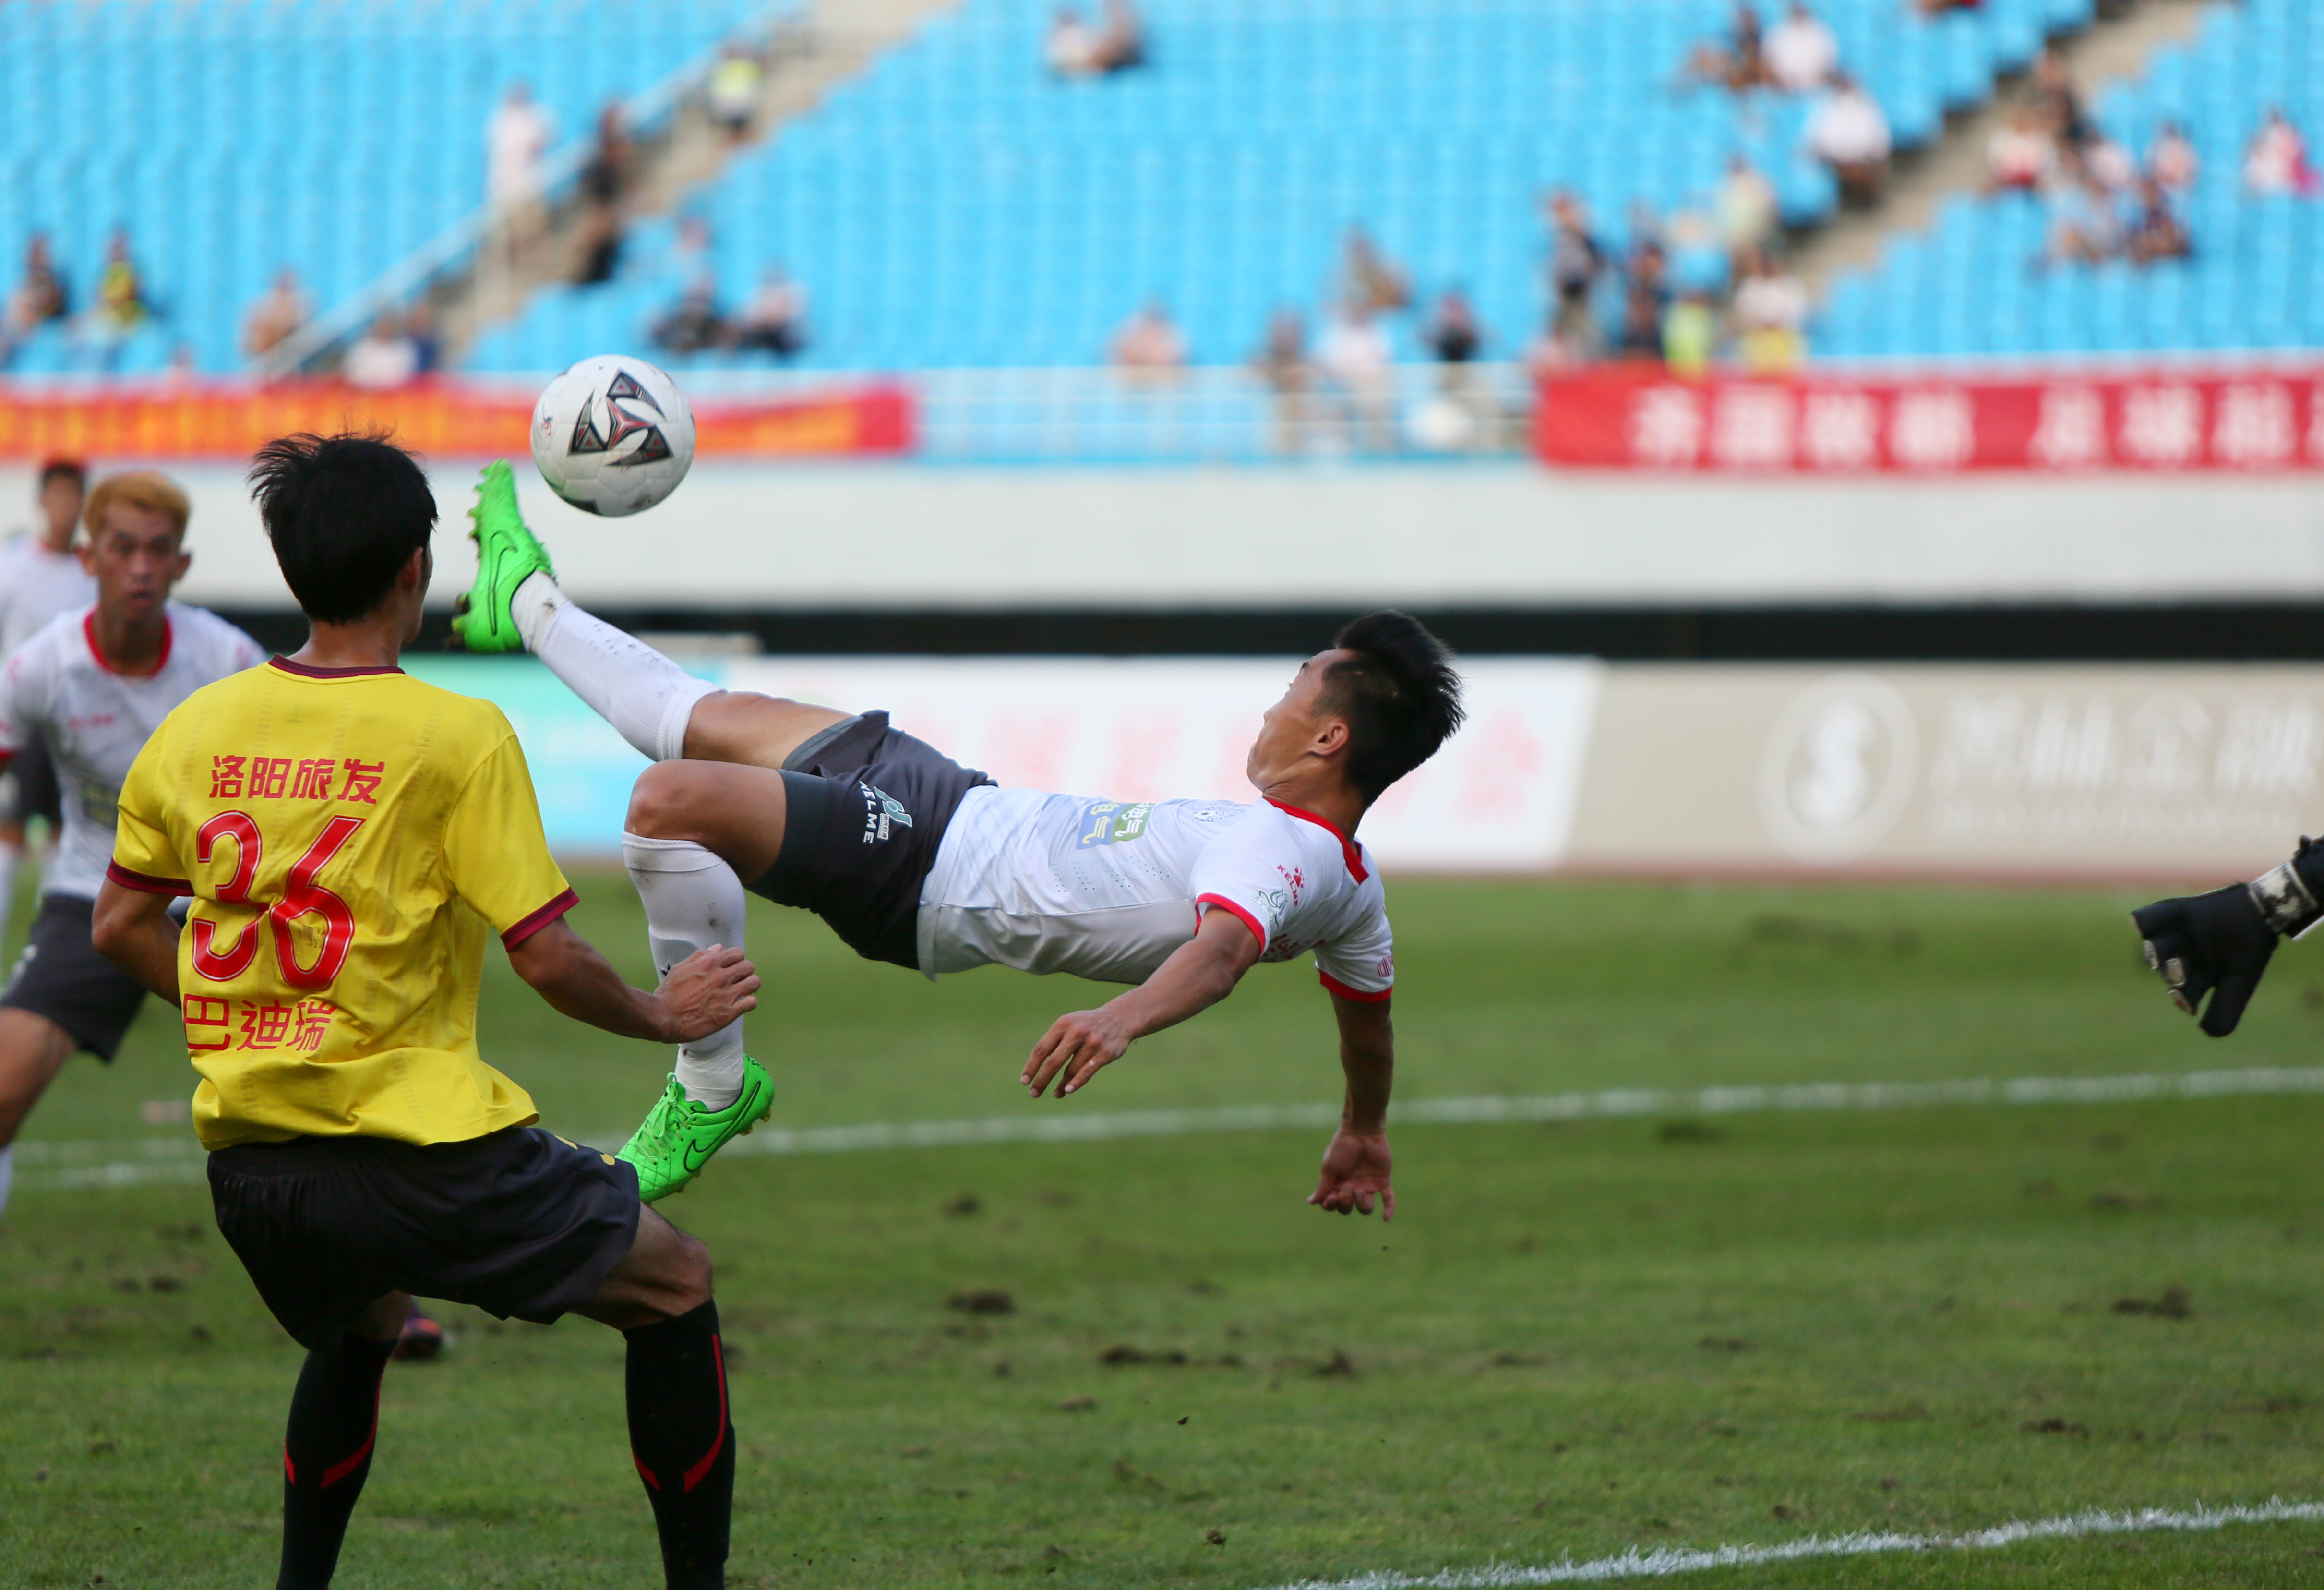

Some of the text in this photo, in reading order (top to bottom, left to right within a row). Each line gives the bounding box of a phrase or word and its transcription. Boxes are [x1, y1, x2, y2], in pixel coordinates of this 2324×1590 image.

[209, 755, 385, 804] 洛阳旅发
[192, 810, 367, 991] 36
[183, 993, 337, 1052] 巴迪瑞
